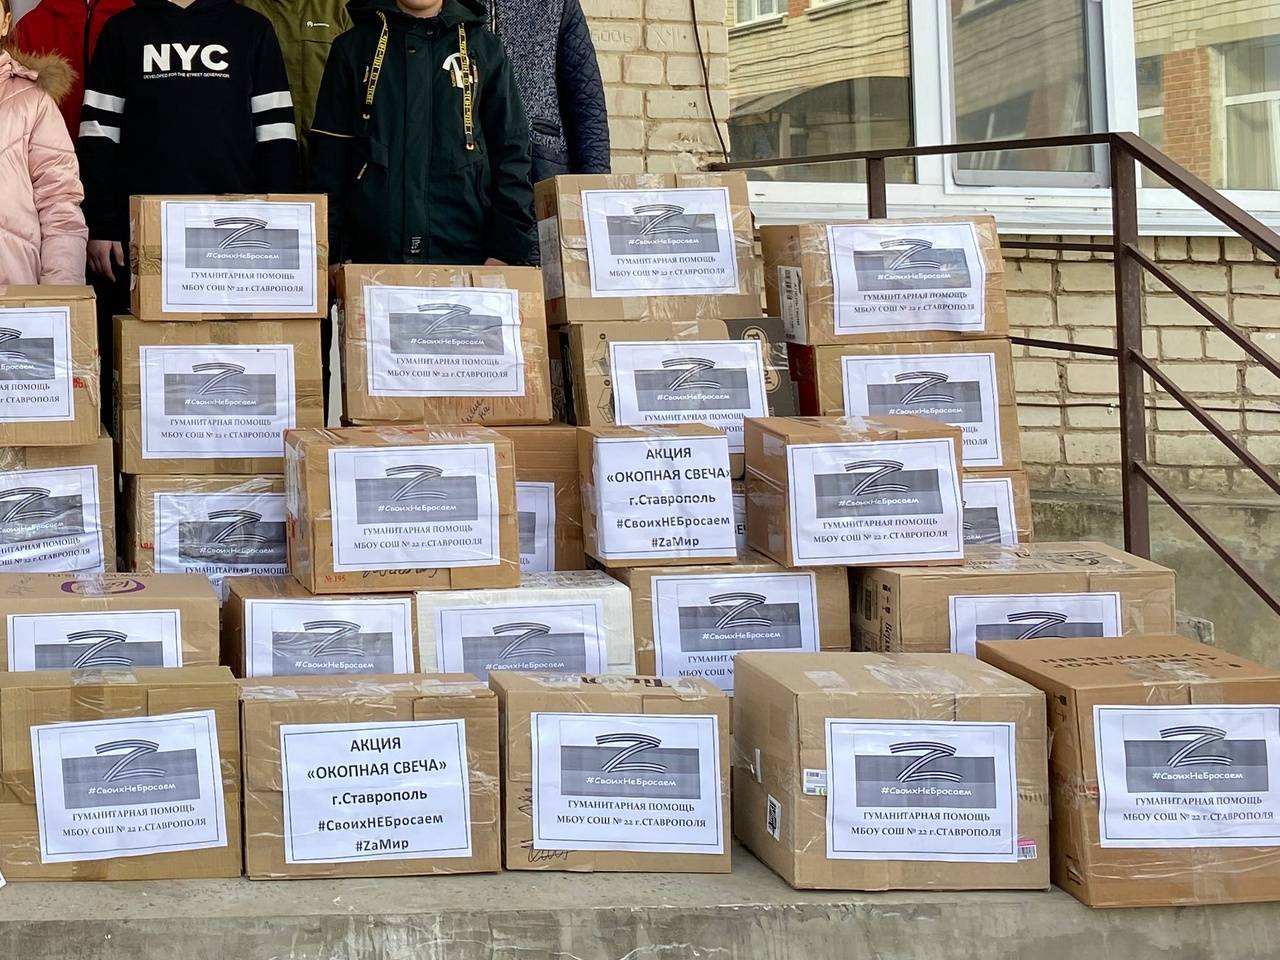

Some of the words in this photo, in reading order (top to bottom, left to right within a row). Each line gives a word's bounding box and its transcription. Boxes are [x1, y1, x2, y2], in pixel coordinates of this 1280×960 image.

[143, 43, 229, 72] NYC
[863, 292, 927, 300] ГУМАНИТАРНАЯ
[929, 291, 967, 299] ПОМОЩЬ
[11, 383, 49, 391] ПОМОЩЬ
[184, 398, 257, 406] #СвоихНеБросаем
[889, 407, 962, 415] #СвоихНеБросаем
[170, 418, 232, 426] ГУМАНИТАРНАЯ
[234, 418, 270, 426] ПОМОЩЬ
[646, 447, 691, 461] АКЦИЯ
[607, 469, 680, 482] «ОКОПНАЯ
[629, 494, 715, 506] г.Ставрополь
[838, 496, 918, 507] #СвоихНеБросаем
[377, 502, 456, 513] #СвоихНеБросаем
[617, 516, 729, 528] #СвоихНЕБросаем
[822, 518, 892, 529] ГУМАНИТАРНАЯ
[895, 517, 937, 526] ПОМОЩЬ
[363, 525, 430, 535] ГУМАНИТАРНАЯ
[432, 524, 472, 533] ПОМОЩЬ
[813, 535, 840, 543] МБОУ
[883, 529, 947, 539] г.СТАВРОПОЛЯ
[42, 537, 80, 547] ПОМОЩЬ
[652, 536, 700, 551] #ZaМир
[702, 631, 781, 640] #СвоихНеБросаем
[294, 660, 375, 669] #СвоихНеБросаем
[350, 737, 400, 752] АКЦИЯ
[307, 762, 388, 779] «ОКОПНАЯ
[393, 759, 446, 774] СВЕЧА»
[1152, 771, 1243, 780] #СвоихНеБросаем
[586, 777, 676, 786] #СвоихНеБросаем
[88, 780, 176, 797] #СвоихНеБросаем
[880, 786, 971, 796] #СвоихНеБросаем
[332, 790, 427, 805] г.Ставрополь
[1134, 796, 1213, 805] ГУМАНИТАРНАЯ
[1215, 796, 1262, 805] ПОМОЩЬ
[568, 800, 646, 809] ГУМАНИТАРНАЯ
[648, 803, 694, 811] ПОМОЩЬ
[73, 807, 147, 822] ГУМАНИТАРНАЯ
[150, 803, 194, 816] ПОМОЩЬ
[863, 810, 940, 820] ГУМАНИТАРНАЯ
[943, 812, 990, 821] ПОМОЩЬ
[318, 815, 443, 831] #СвоихНЕБросаем
[557, 815, 586, 824] МБОУ
[587, 816, 610, 824] СОШ
[635, 818, 706, 827] г.СТАВРОПОЛЯ
[851, 827, 881, 835] МБОУ
[882, 827, 904, 835] СОШ
[907, 827, 916, 835] №
[930, 827, 1001, 836] г.СТАВРОПОЛЯ
[356, 838, 408, 851] #ZaМир
